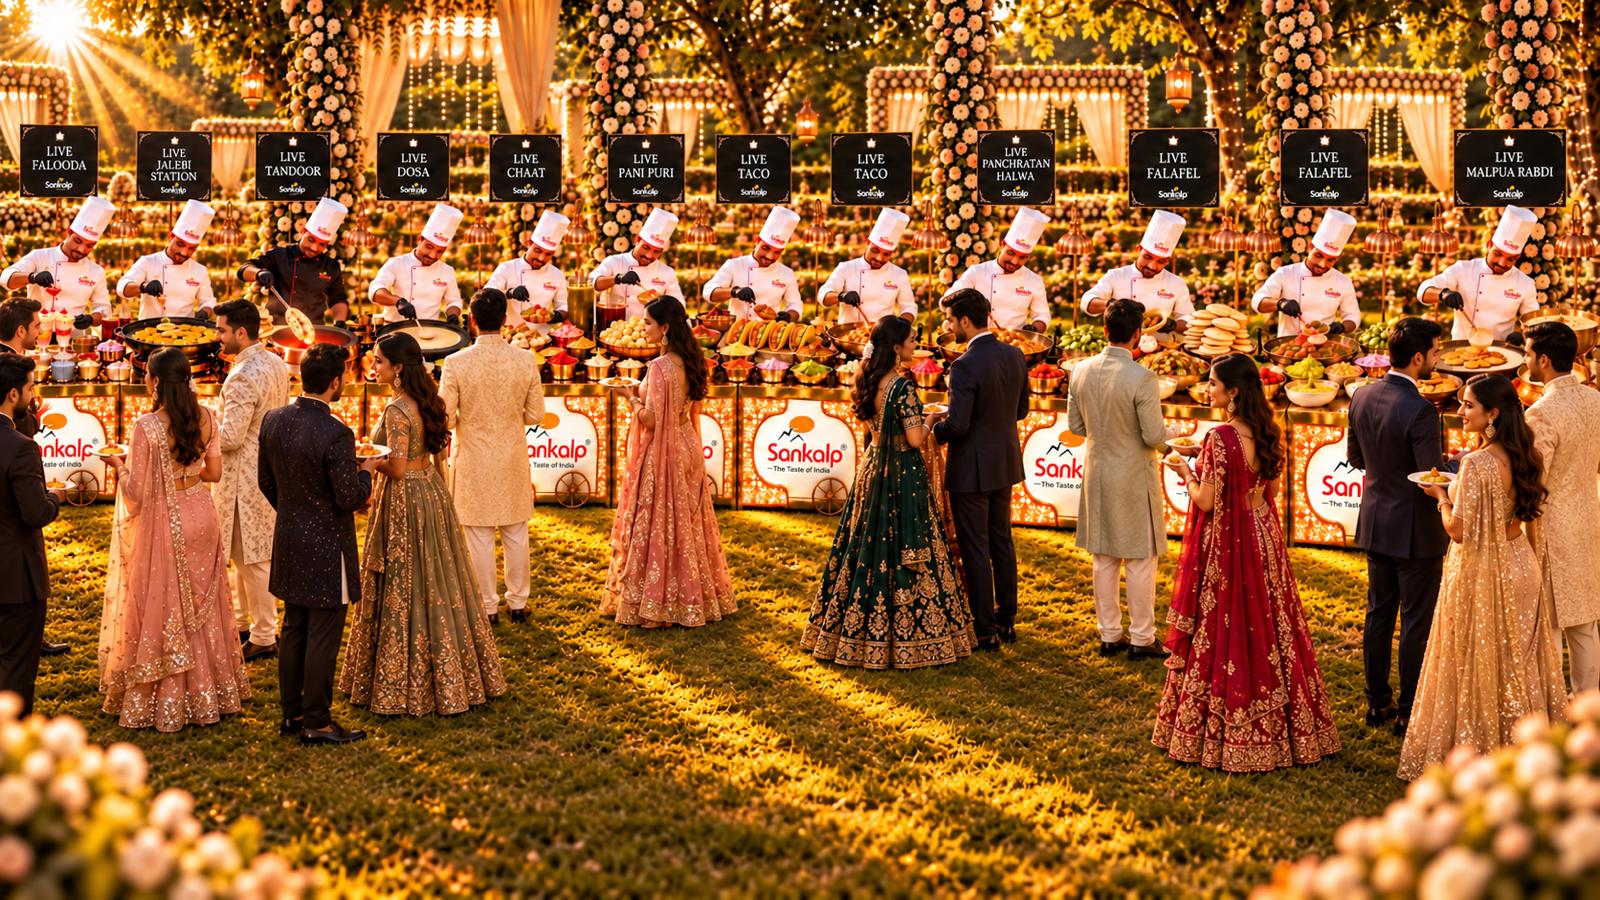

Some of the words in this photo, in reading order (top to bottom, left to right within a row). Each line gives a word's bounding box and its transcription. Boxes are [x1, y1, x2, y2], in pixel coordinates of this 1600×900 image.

[47, 146, 72, 156] LIVE
[162, 149, 186, 158] LIVE
[1005, 148, 1027, 157] LIVE
[280, 152, 306, 162] LIVE
[402, 153, 427, 163] LIVE
[514, 154, 538, 164] LIVE
[634, 154, 658, 164] LIVE
[741, 154, 767, 164] LIVE
[858, 154, 884, 164] LIVE
[1159, 152, 1188, 164] LIVE
[1310, 152, 1338, 163] LIVE
[1495, 152, 1524, 162] LIVE
[32, 160, 86, 170] FALOODA
[156, 160, 191, 171] JALEBI
[984, 159, 1050, 168] PANCHRATAN
[264, 166, 321, 176] TANDOOR
[398, 167, 430, 177] DOSA
[507, 168, 546, 178] CHAAT
[618, 168, 645, 178] PANI
[648, 168, 674, 178] PURI
[738, 168, 770, 179] TACO
[854, 168, 888, 179] TACO
[996, 171, 1034, 181] HALWA
[1147, 168, 1200, 179] FALAFEL
[1299, 167, 1352, 178] FALAFEL
[1466, 166, 1516, 178] MALPUA
[1519, 166, 1553, 178] RABDI
[150, 172, 196, 182] STATION
[38, 438, 93, 462] nkalp
[527, 438, 587, 463] ankalp
[768, 442, 842, 468] Sankalp
[1034, 458, 1082, 478] Sank
